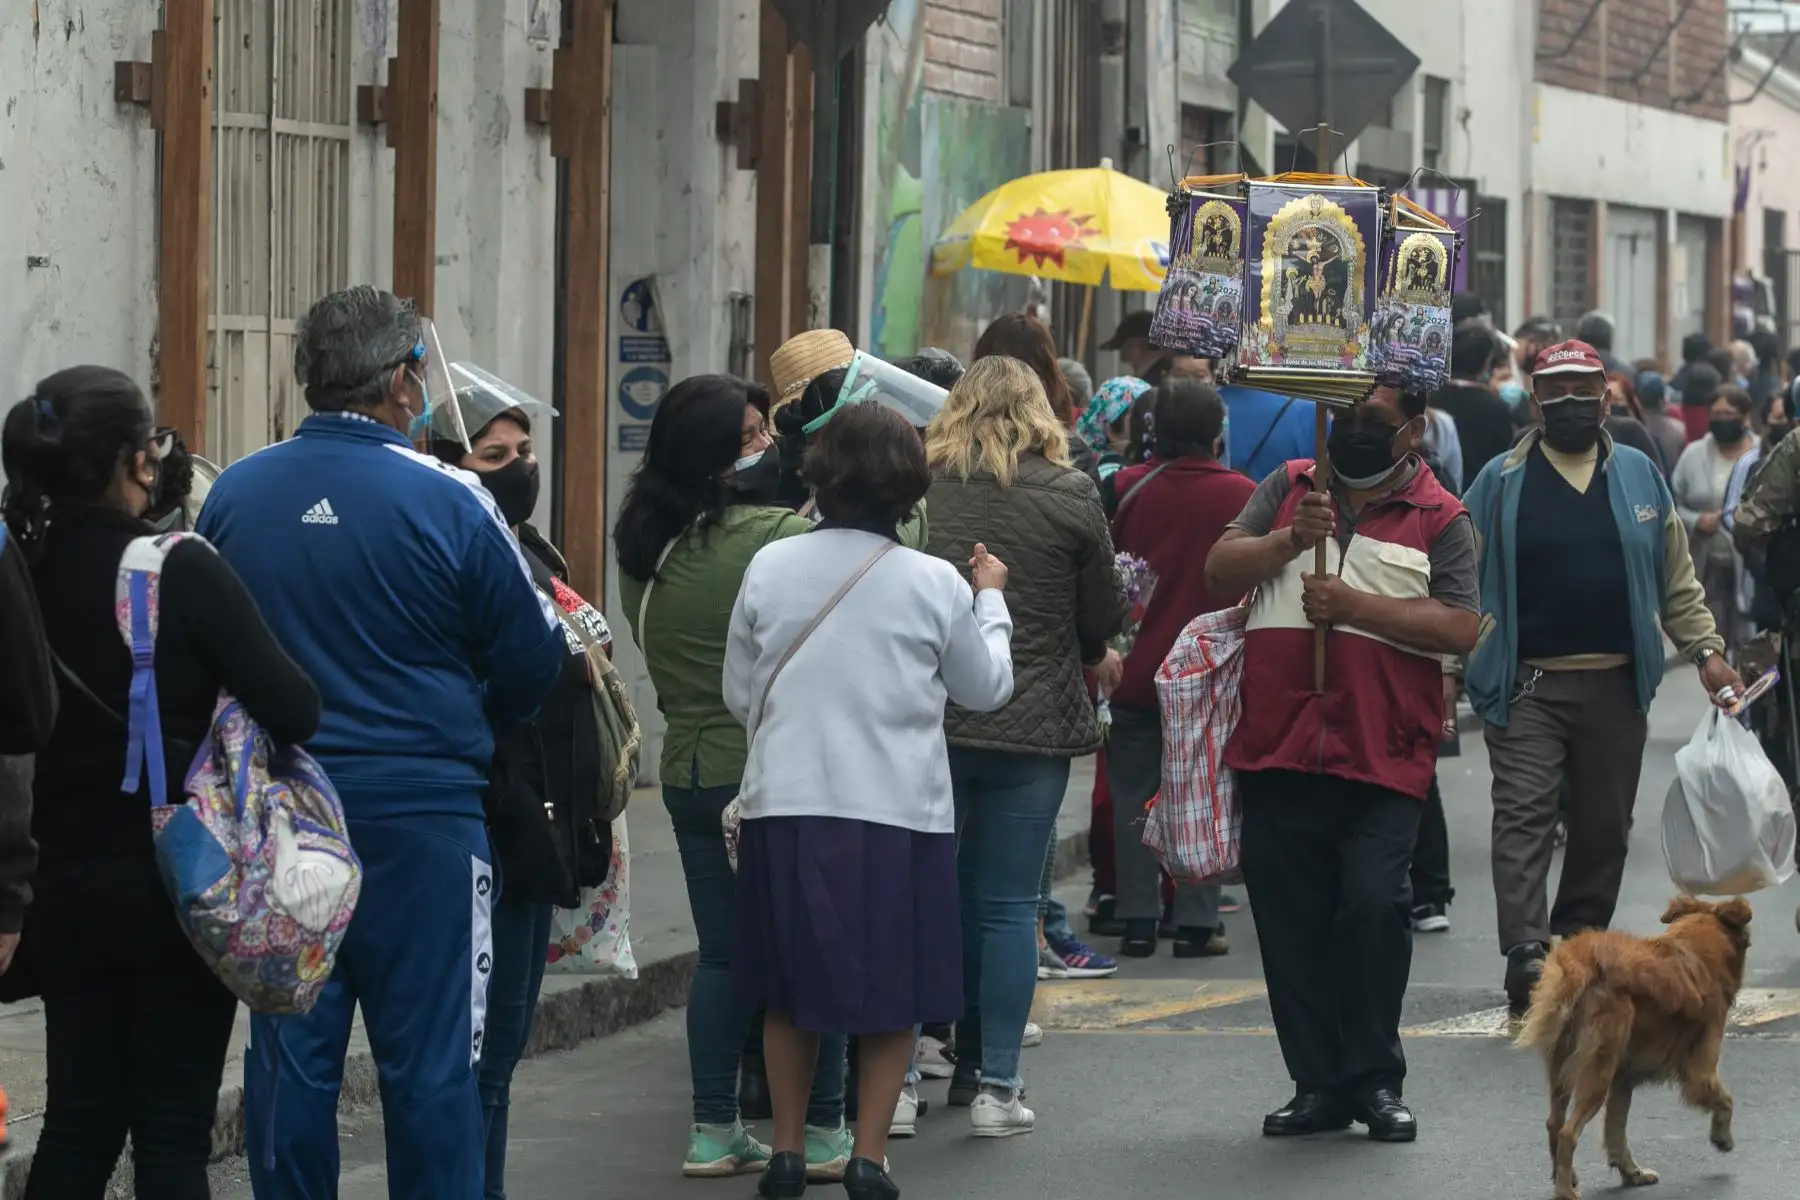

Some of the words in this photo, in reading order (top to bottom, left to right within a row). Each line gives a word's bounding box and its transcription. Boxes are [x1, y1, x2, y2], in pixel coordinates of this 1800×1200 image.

[1219, 286, 1239, 295] 2022
[1426, 316, 1448, 325] 2022
[301, 513, 339, 525] adidas
